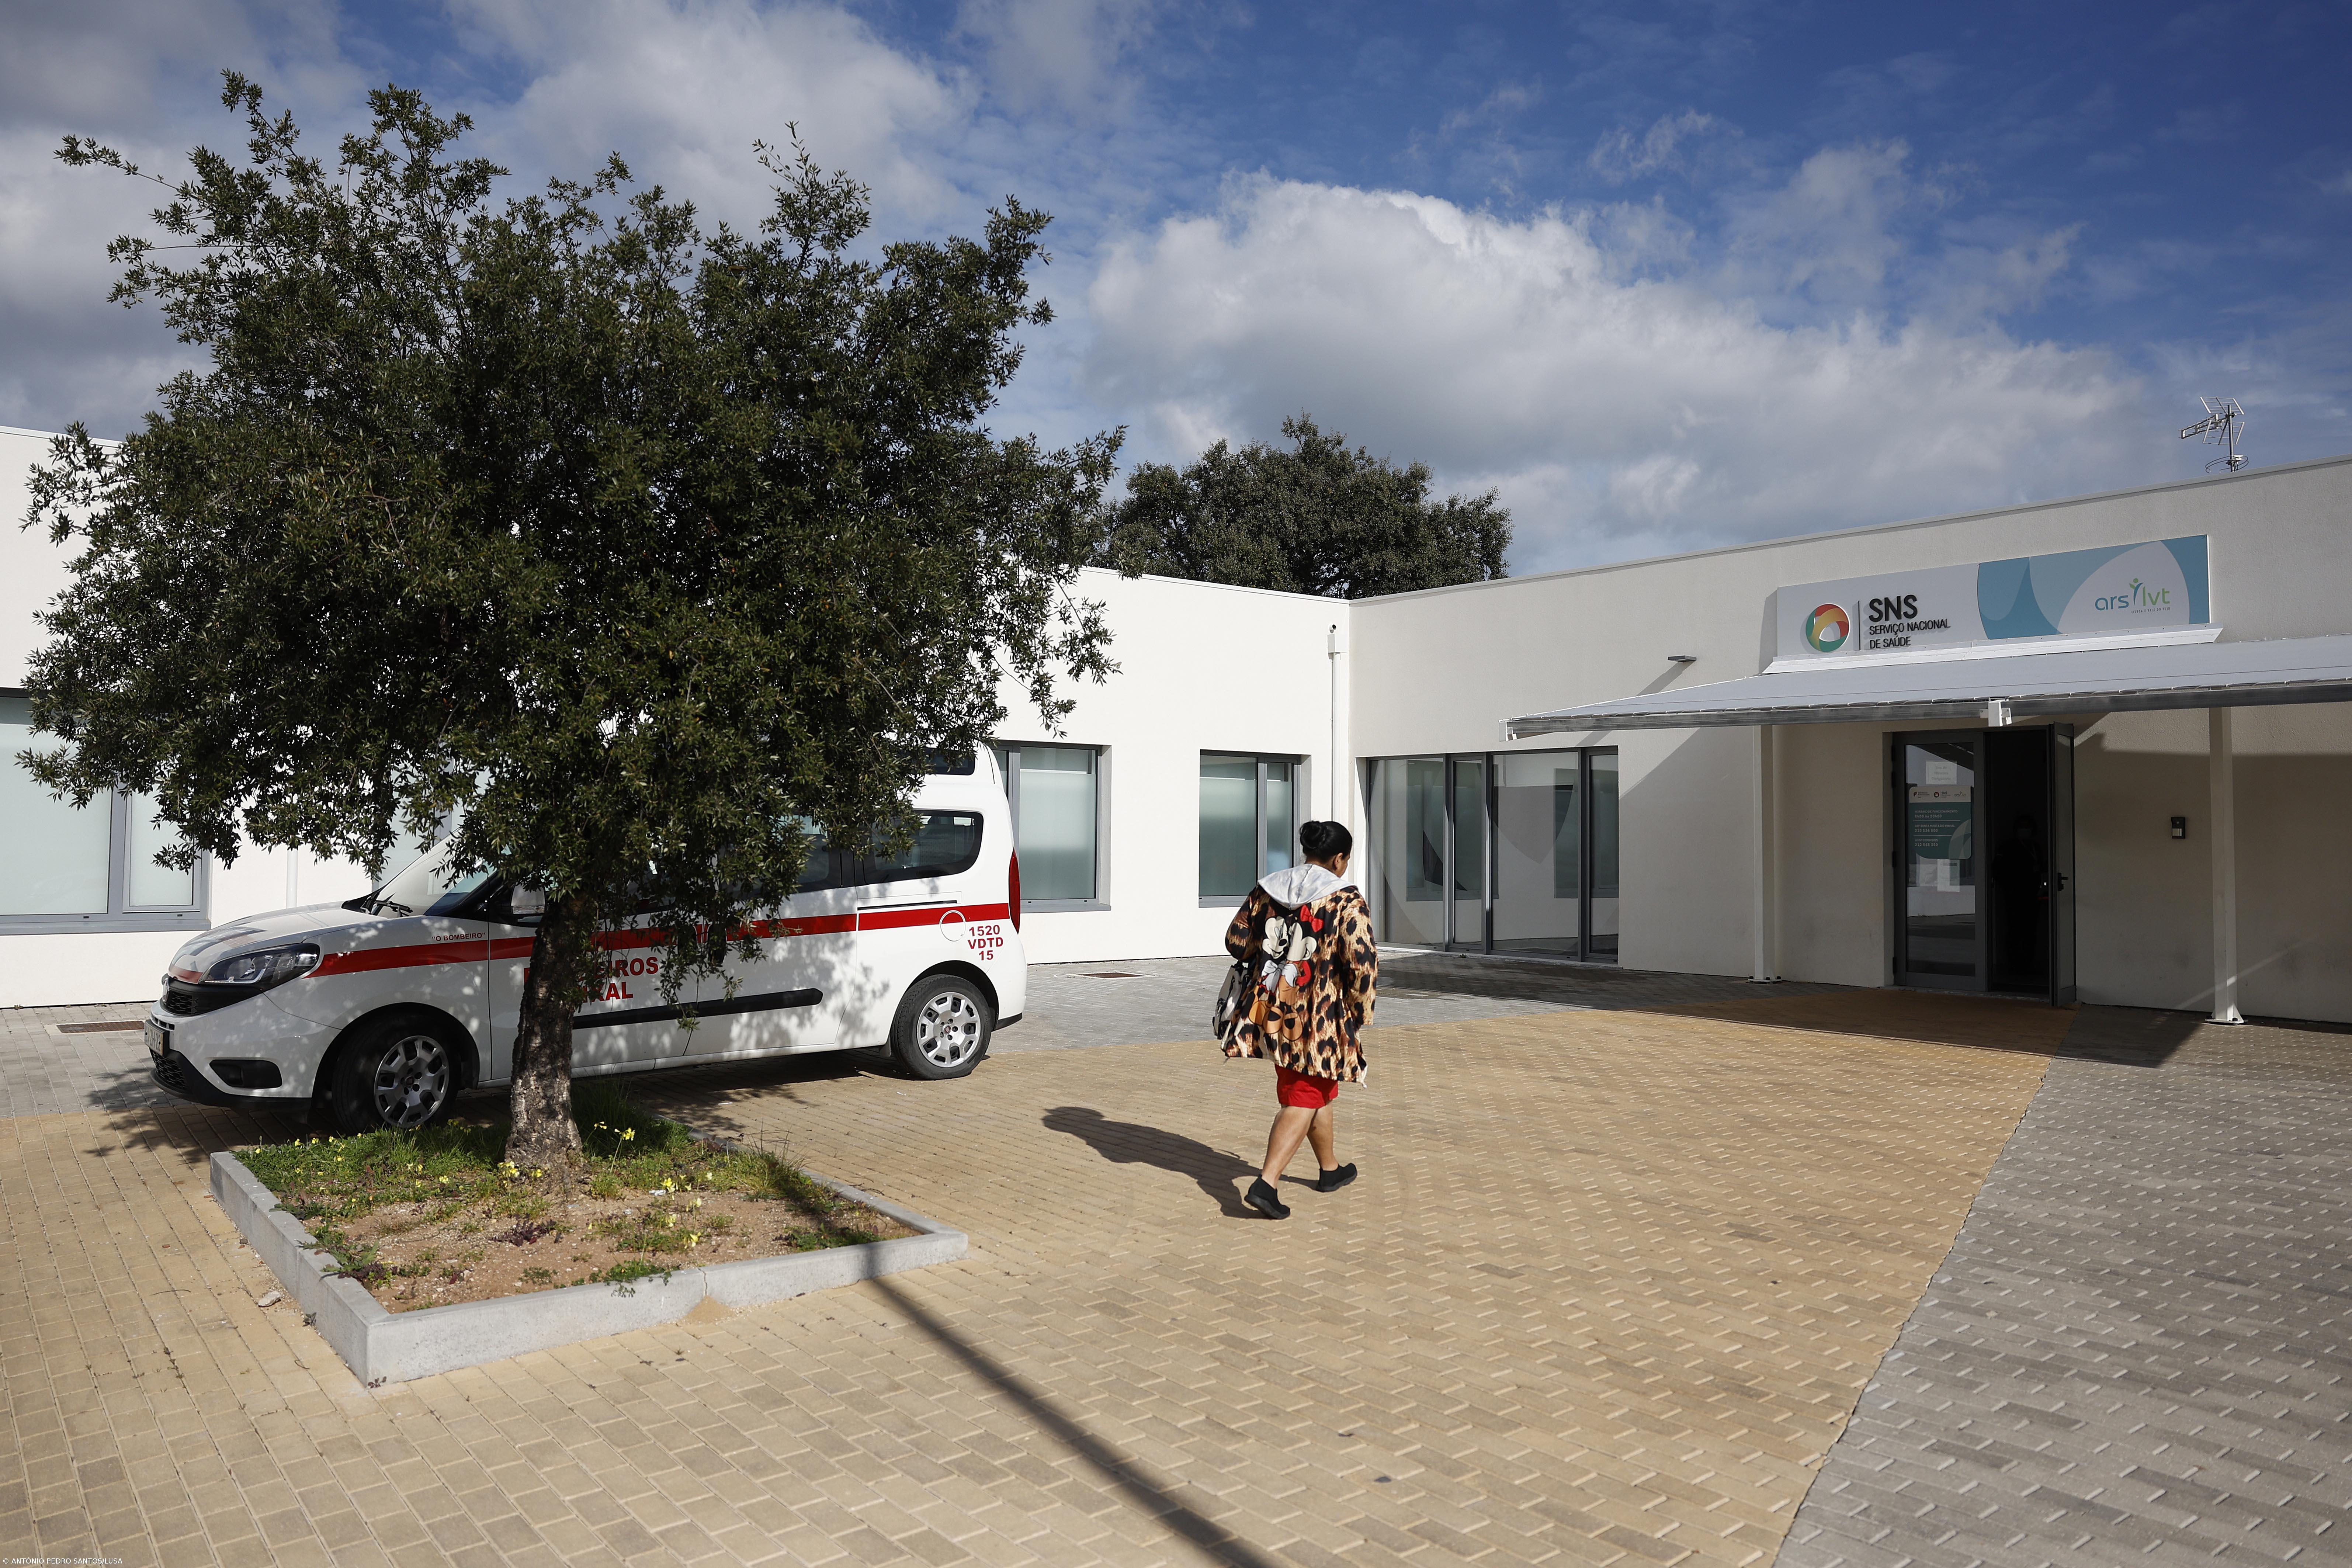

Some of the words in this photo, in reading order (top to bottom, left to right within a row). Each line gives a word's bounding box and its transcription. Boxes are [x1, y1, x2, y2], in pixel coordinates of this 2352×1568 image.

[2095, 595, 2129, 611] ars
[2143, 586, 2170, 606] lvt
[1869, 594, 1918, 622] SNS
[1869, 623, 1905, 635] SERVIÇO
[1907, 618, 1951, 632] NACIONAL
[1870, 639, 1881, 649] DE
[1883, 635, 1911, 648] SAÚDE
[969, 925, 1000, 936] 1520
[967, 937, 1003, 949] VDTD
[979, 950, 993, 961] 15
